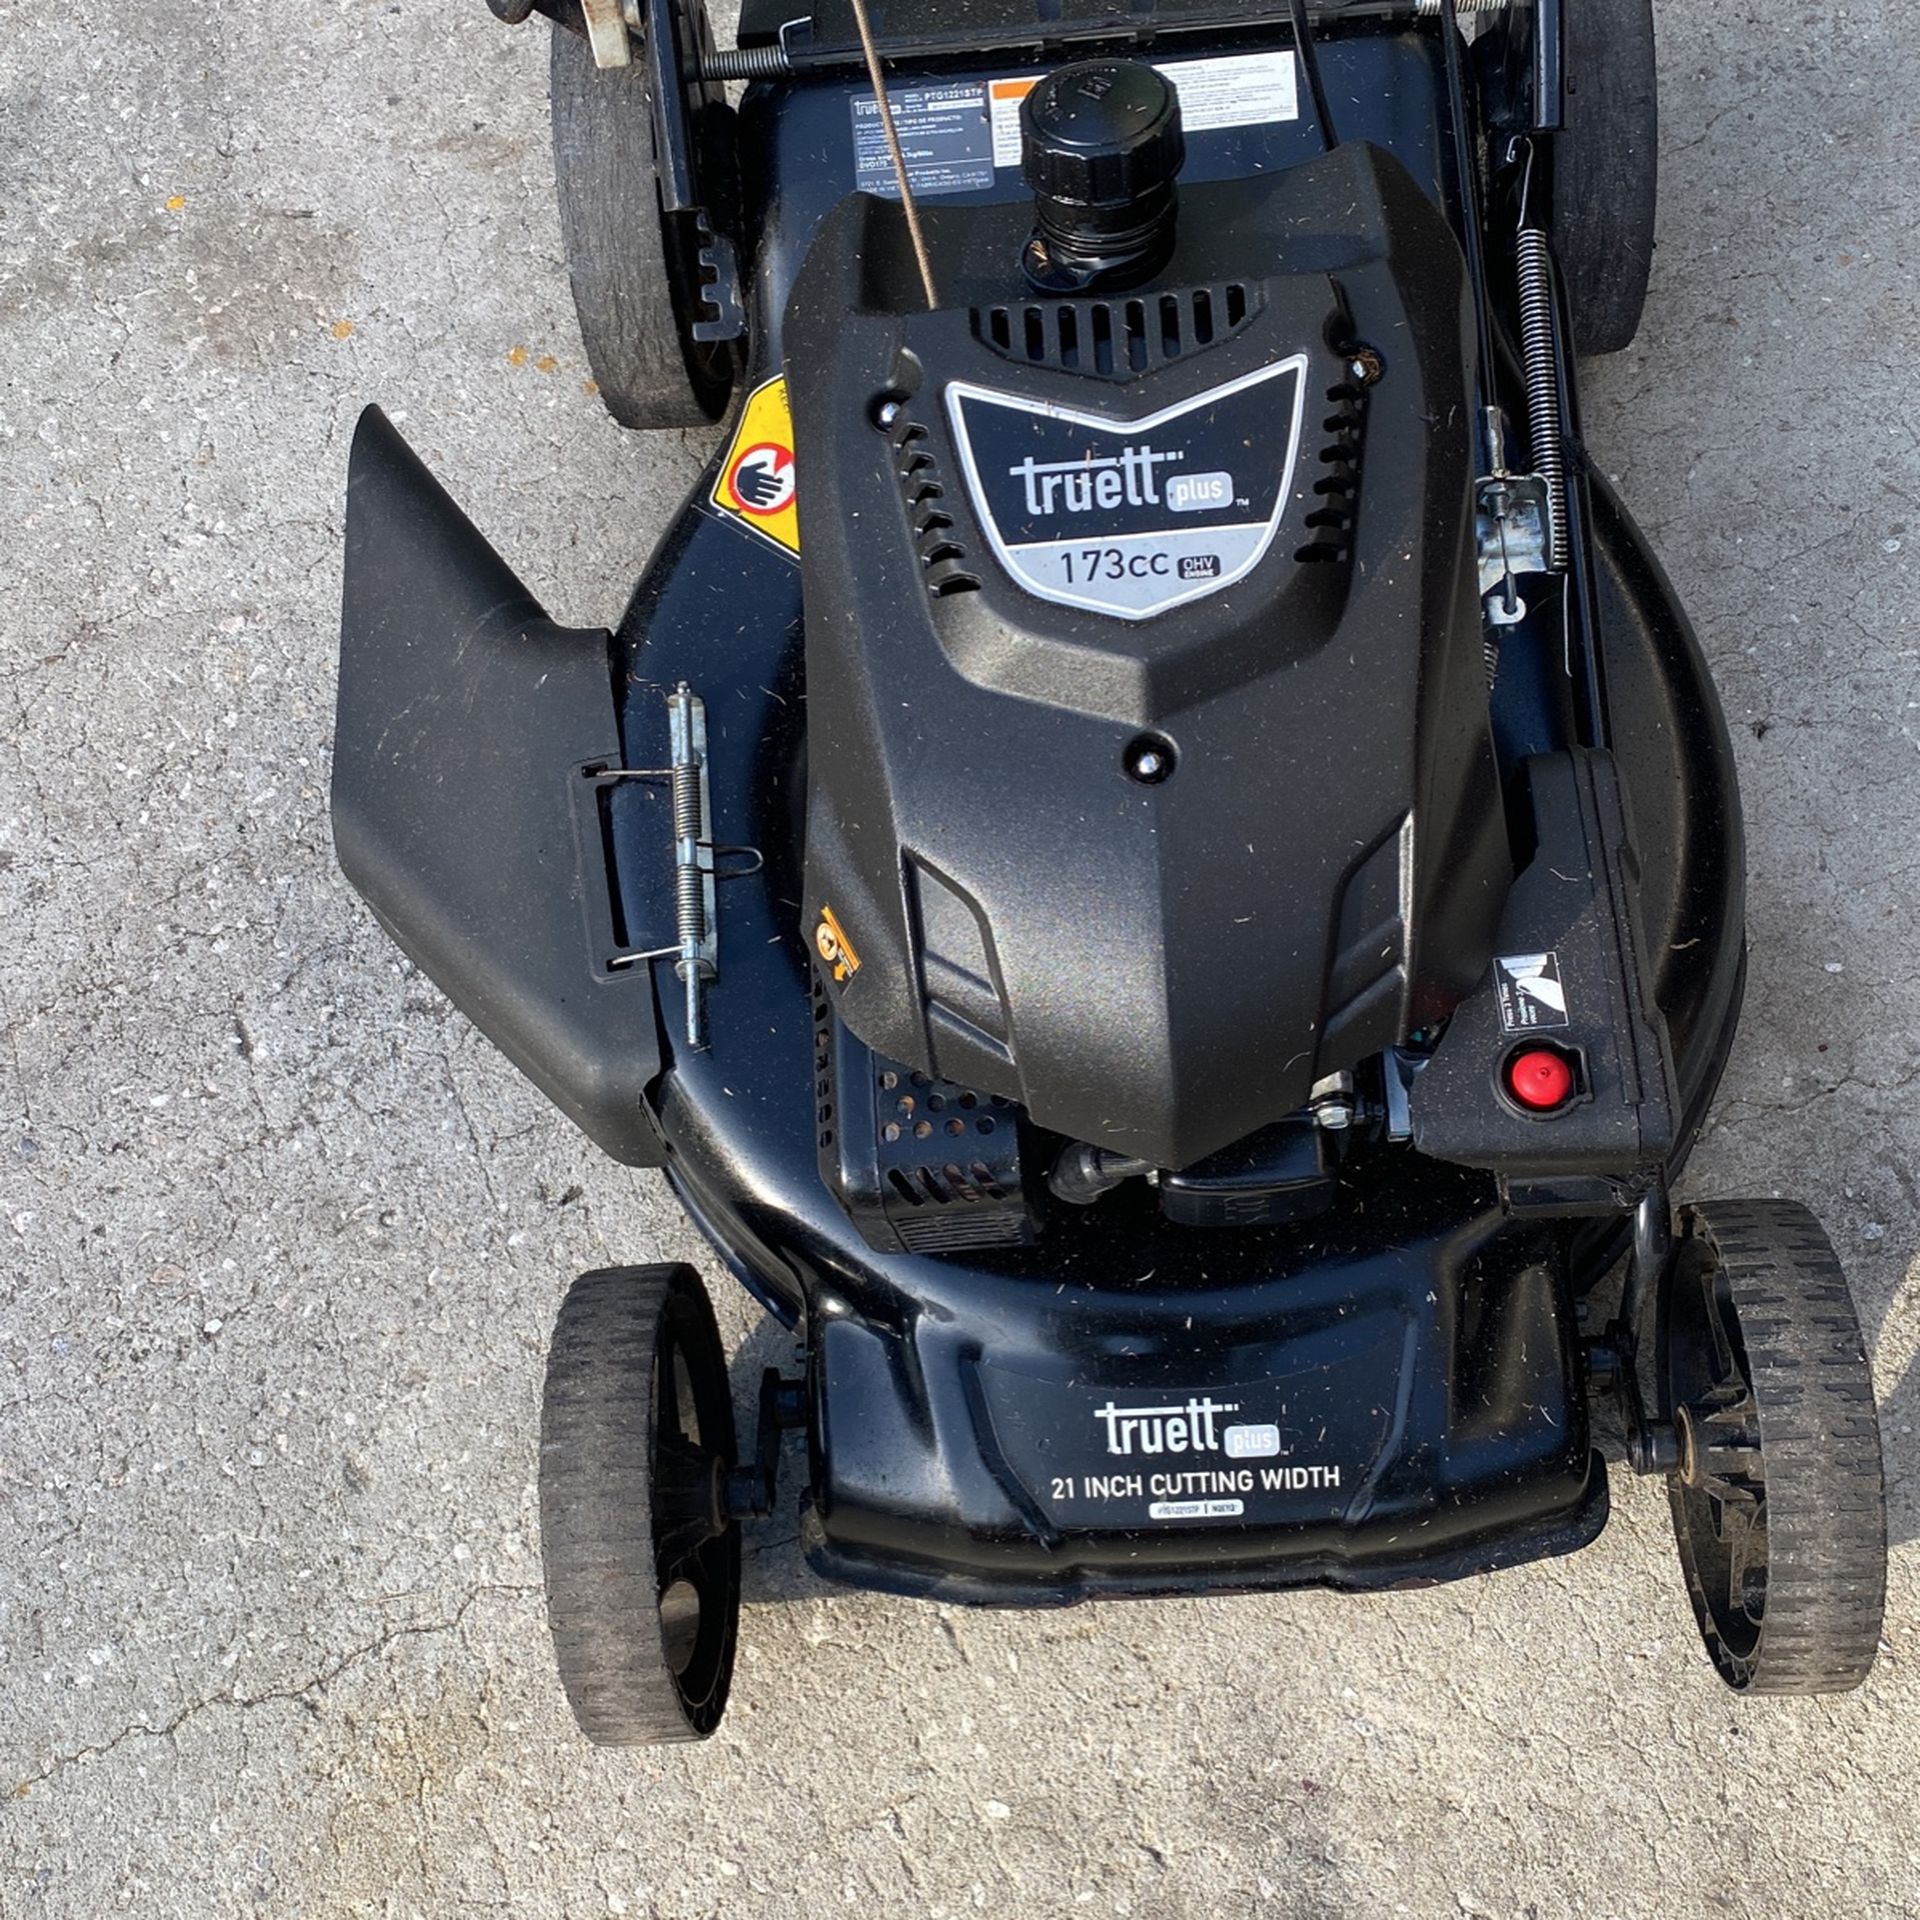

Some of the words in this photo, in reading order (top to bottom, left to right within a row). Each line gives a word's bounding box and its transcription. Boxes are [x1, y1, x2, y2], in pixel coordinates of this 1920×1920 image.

[1009, 446, 1184, 516] truett
[1176, 477, 1223, 507] plus
[1060, 548, 1170, 584] 173cc
[1183, 556, 1214, 570] OHV
[1094, 1397, 1239, 1454] truett
[1232, 1427, 1273, 1451] plus
[1051, 1477, 1075, 1499] 21
[1084, 1475, 1143, 1499] INCH
[1150, 1470, 1254, 1496] CUTTING
[1260, 1465, 1341, 1490] WIDTH
